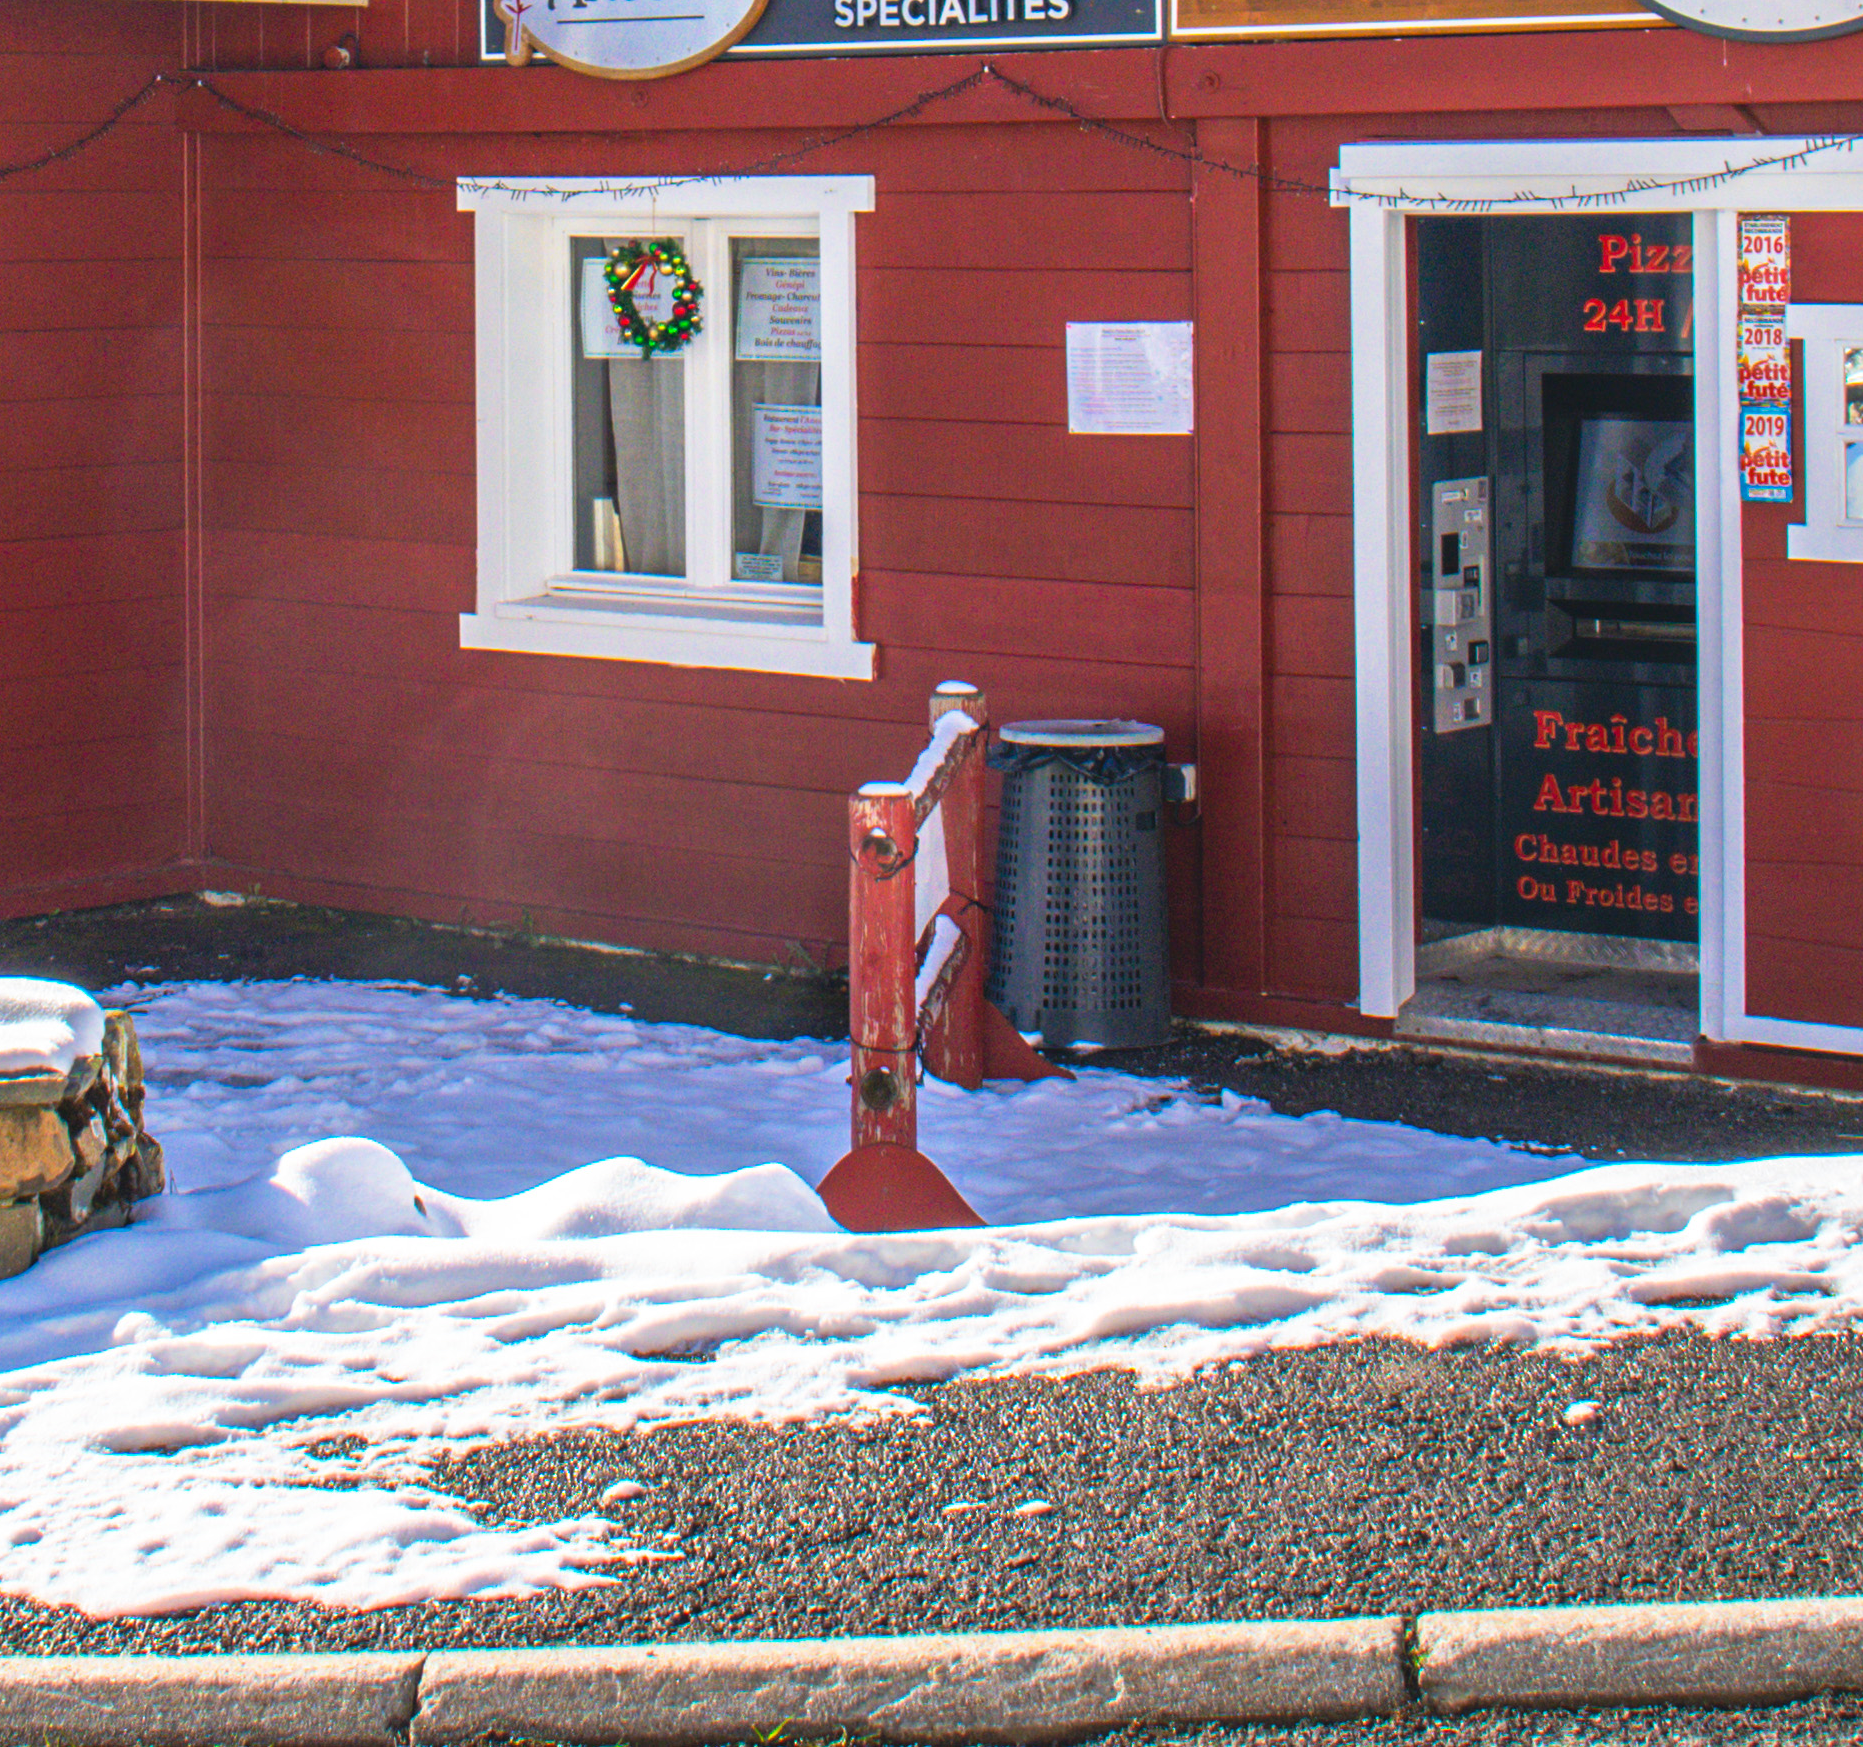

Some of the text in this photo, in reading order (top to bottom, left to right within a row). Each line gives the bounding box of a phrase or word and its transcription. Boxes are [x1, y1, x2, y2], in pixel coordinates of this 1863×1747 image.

[1599, 233, 1693, 273] Pizz
[1743, 235, 1783, 254] 2016
[1738, 266, 1788, 288] petit
[1583, 298, 1665, 332] 24H
[1744, 328, 1782, 345] 2018
[1739, 363, 1788, 384] petit
[1746, 380, 1789, 398] futé
[1745, 415, 1784, 437] 2019
[1740, 450, 1790, 471] petit
[1514, 834, 1657, 873] Chaudes
[1517, 876, 1556, 903] Ou
[1566, 880, 1673, 914] Froides
